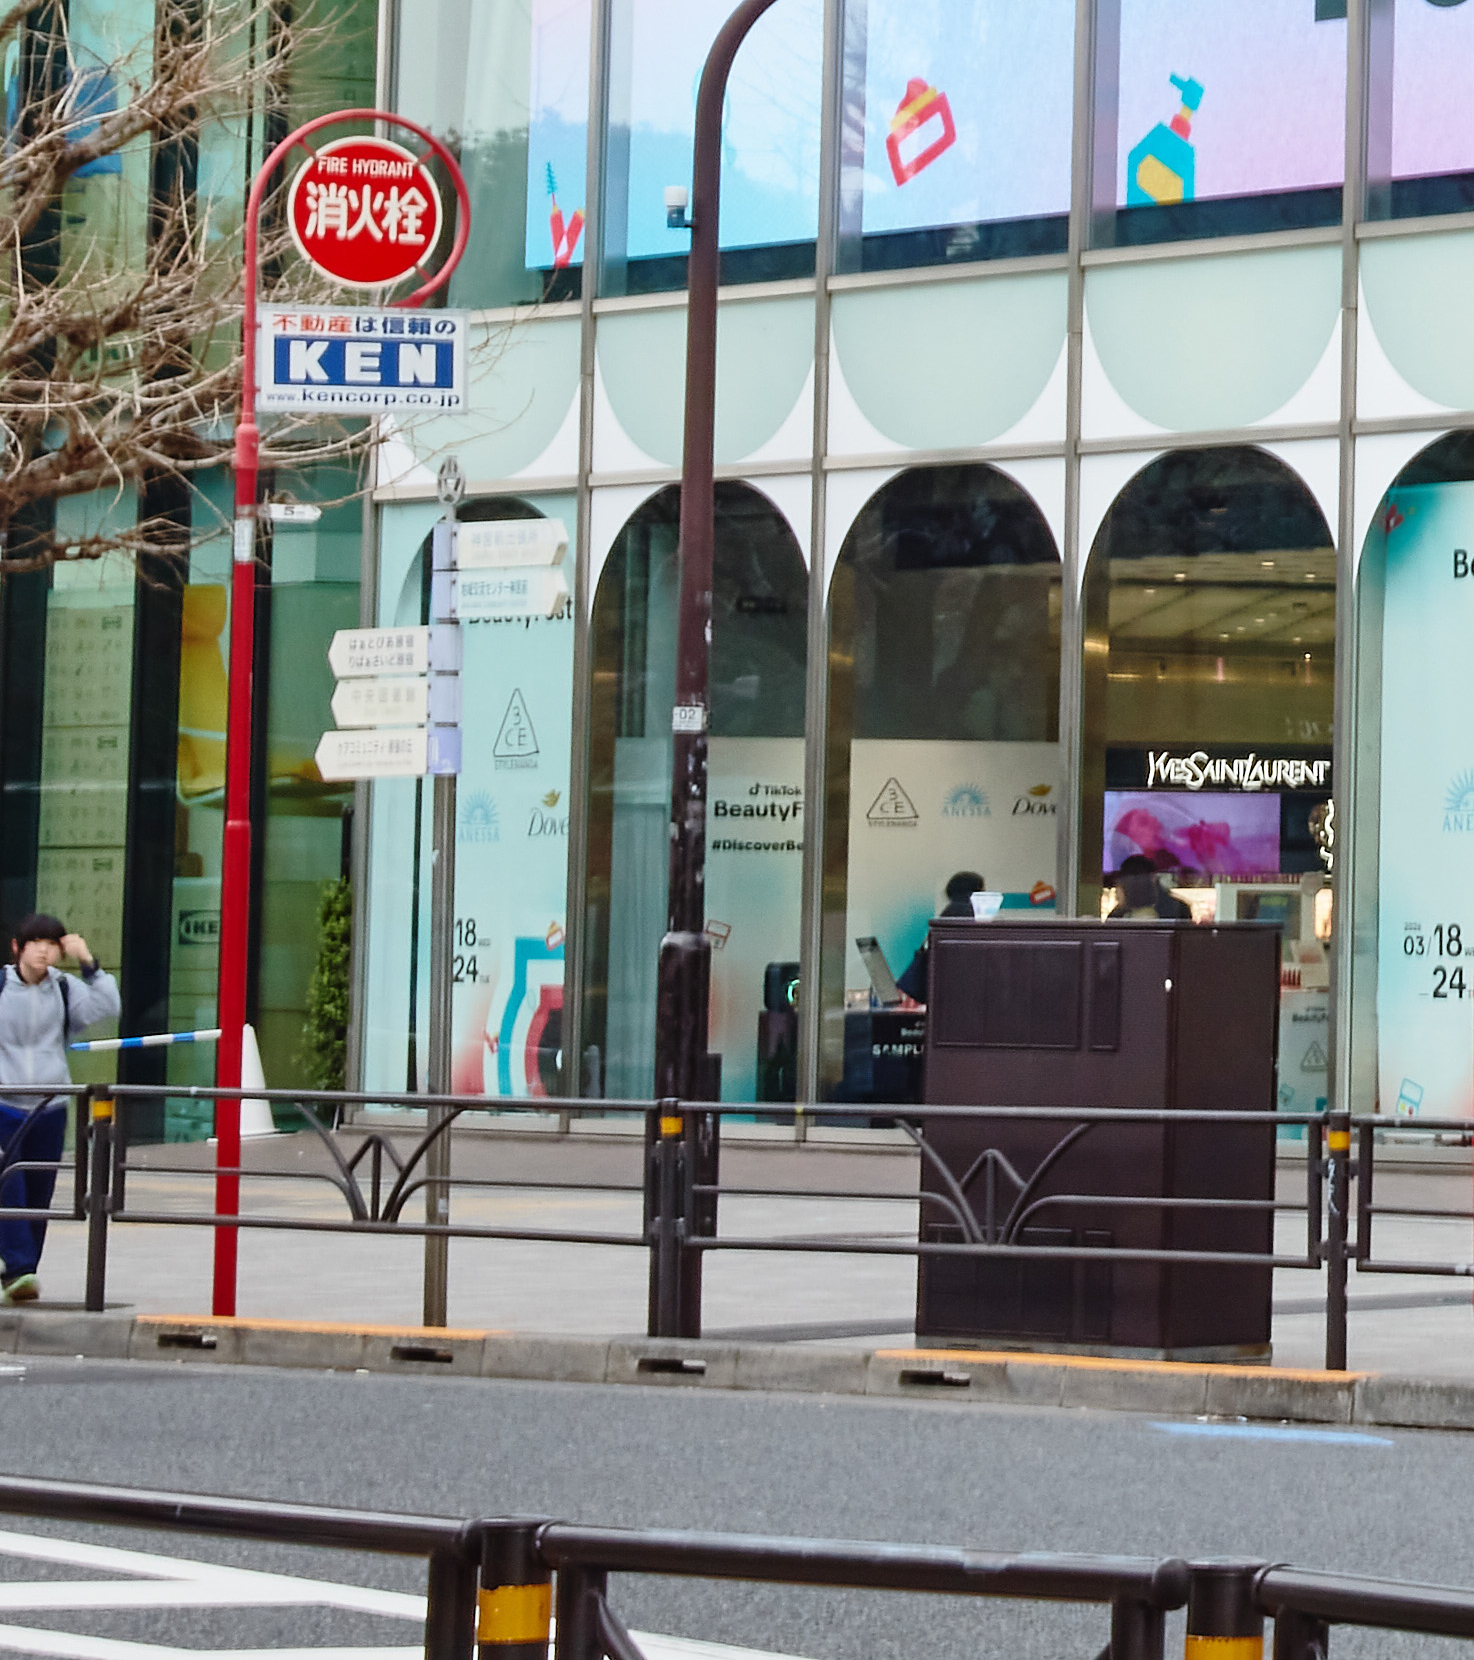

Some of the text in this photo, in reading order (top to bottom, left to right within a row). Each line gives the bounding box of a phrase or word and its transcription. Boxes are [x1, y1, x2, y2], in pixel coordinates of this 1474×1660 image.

[317, 156, 415, 178] FIRE HYDRANT
[304, 181, 428, 245] 消火栓
[272, 313, 457, 334] 不動産は信頼の
[288, 340, 437, 383] KEN
[265, 388, 461, 407] www.kencorp.co.jp
[455, 918, 477, 947] 18
[453, 955, 478, 983] 24
[1432, 965, 1467, 999] 24
